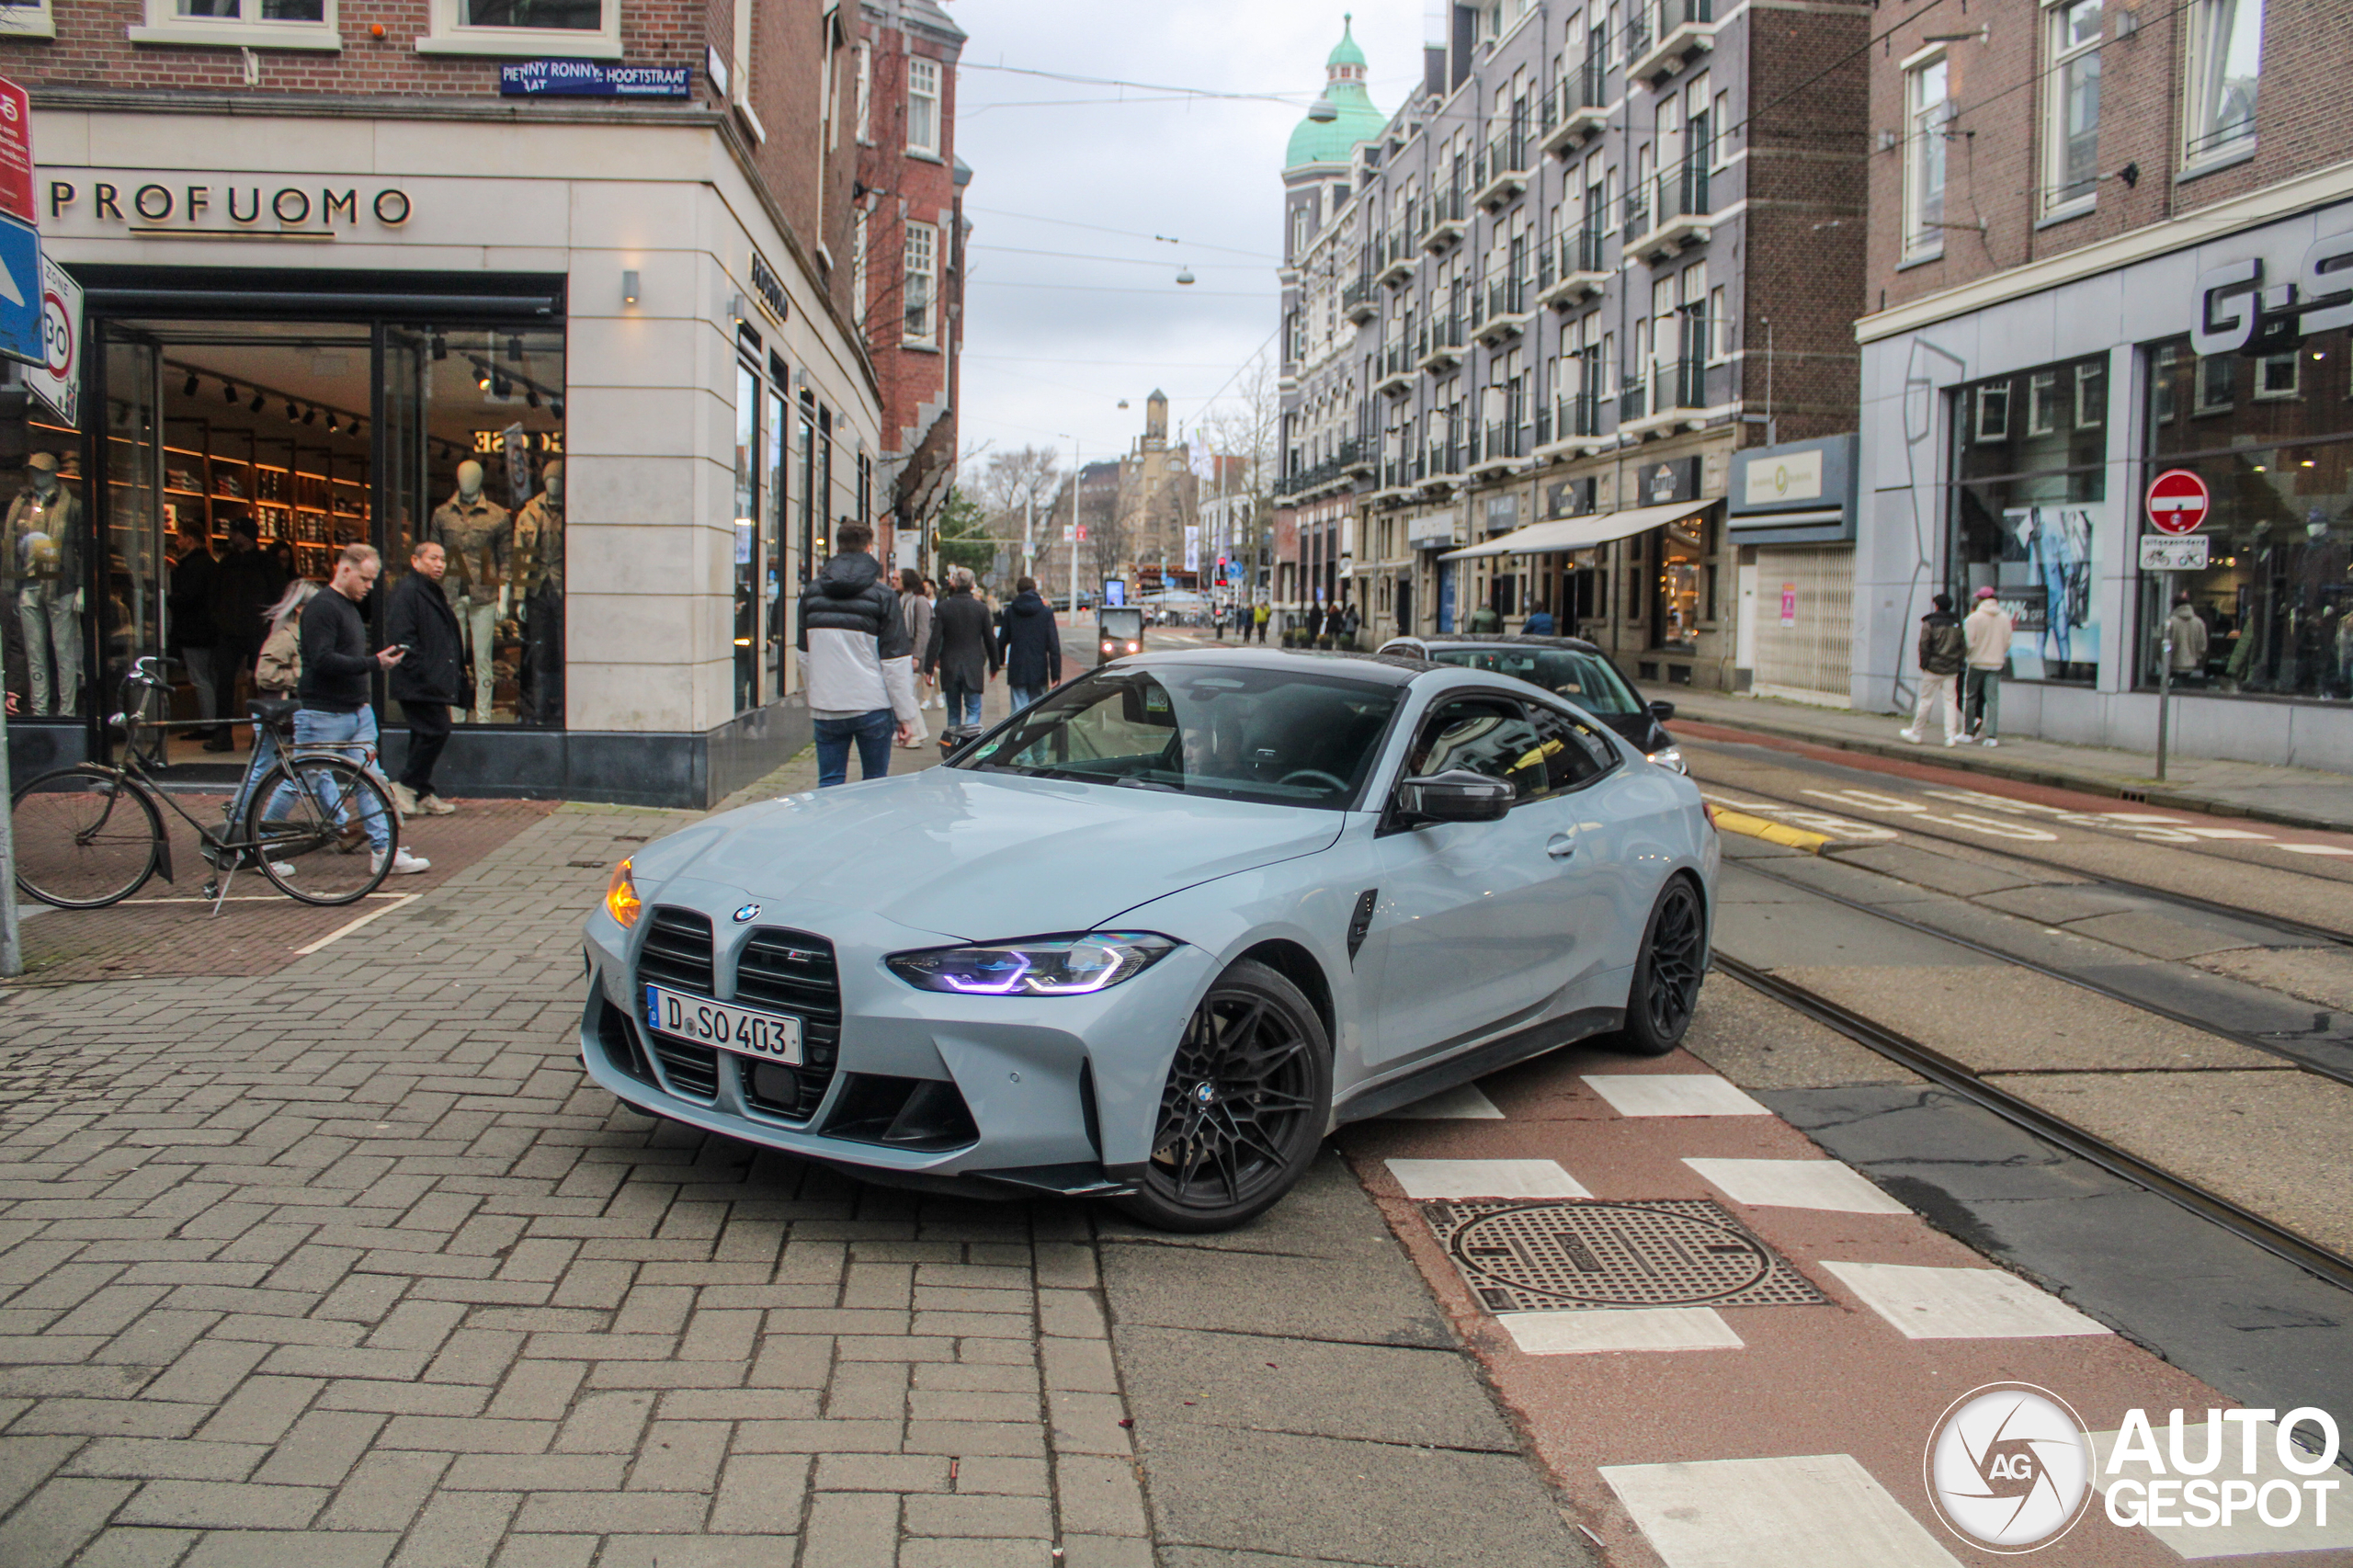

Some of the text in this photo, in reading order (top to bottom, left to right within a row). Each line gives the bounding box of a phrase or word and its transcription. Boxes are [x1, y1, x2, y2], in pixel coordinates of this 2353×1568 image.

[551, 62, 598, 78] RONNY
[607, 68, 687, 85] HOOFTSTRAAT
[51, 181, 412, 226] PROFUOMO
[45, 265, 70, 297] ZONE
[44, 312, 67, 357] 30
[2144, 539, 2206, 547] uitgezonderd
[667, 996, 786, 1055] D SO 403
